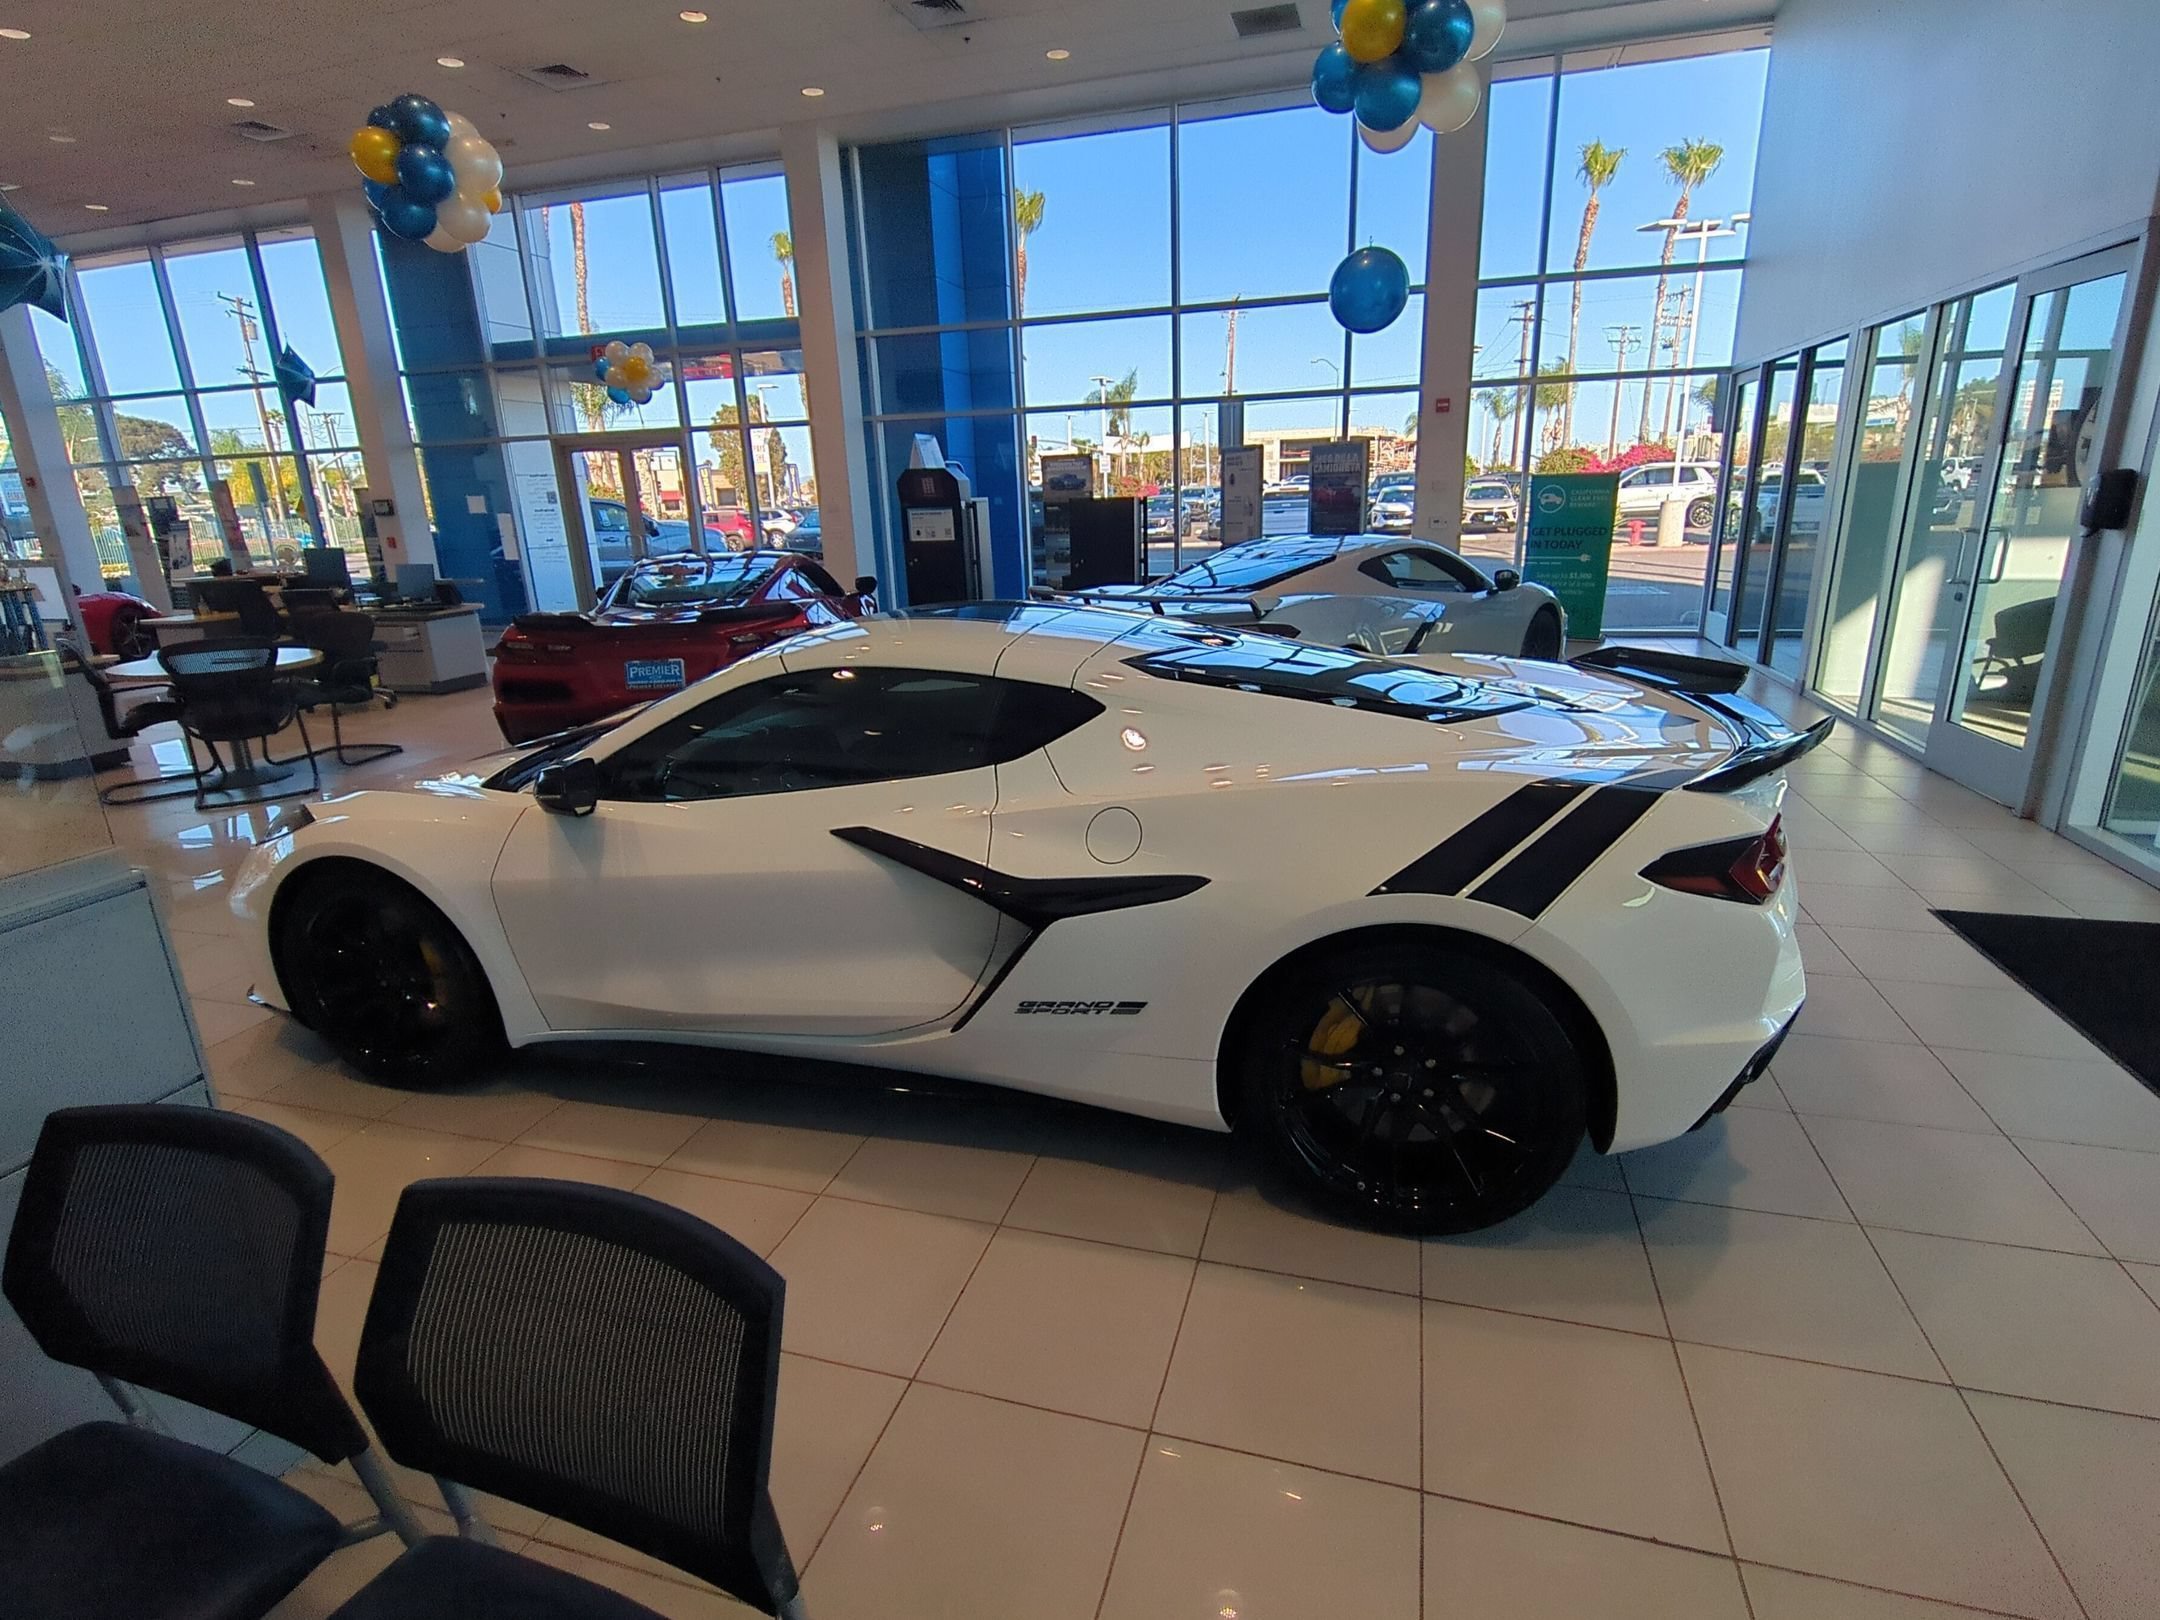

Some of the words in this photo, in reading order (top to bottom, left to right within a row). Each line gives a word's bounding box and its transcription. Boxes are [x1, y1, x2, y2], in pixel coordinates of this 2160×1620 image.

[1532, 527, 1553, 536] GET
[1554, 527, 1608, 536] PLUGGED
[1530, 541, 1542, 549] IN
[1545, 541, 1583, 549] TODAY
[629, 664, 681, 678] PREMIER
